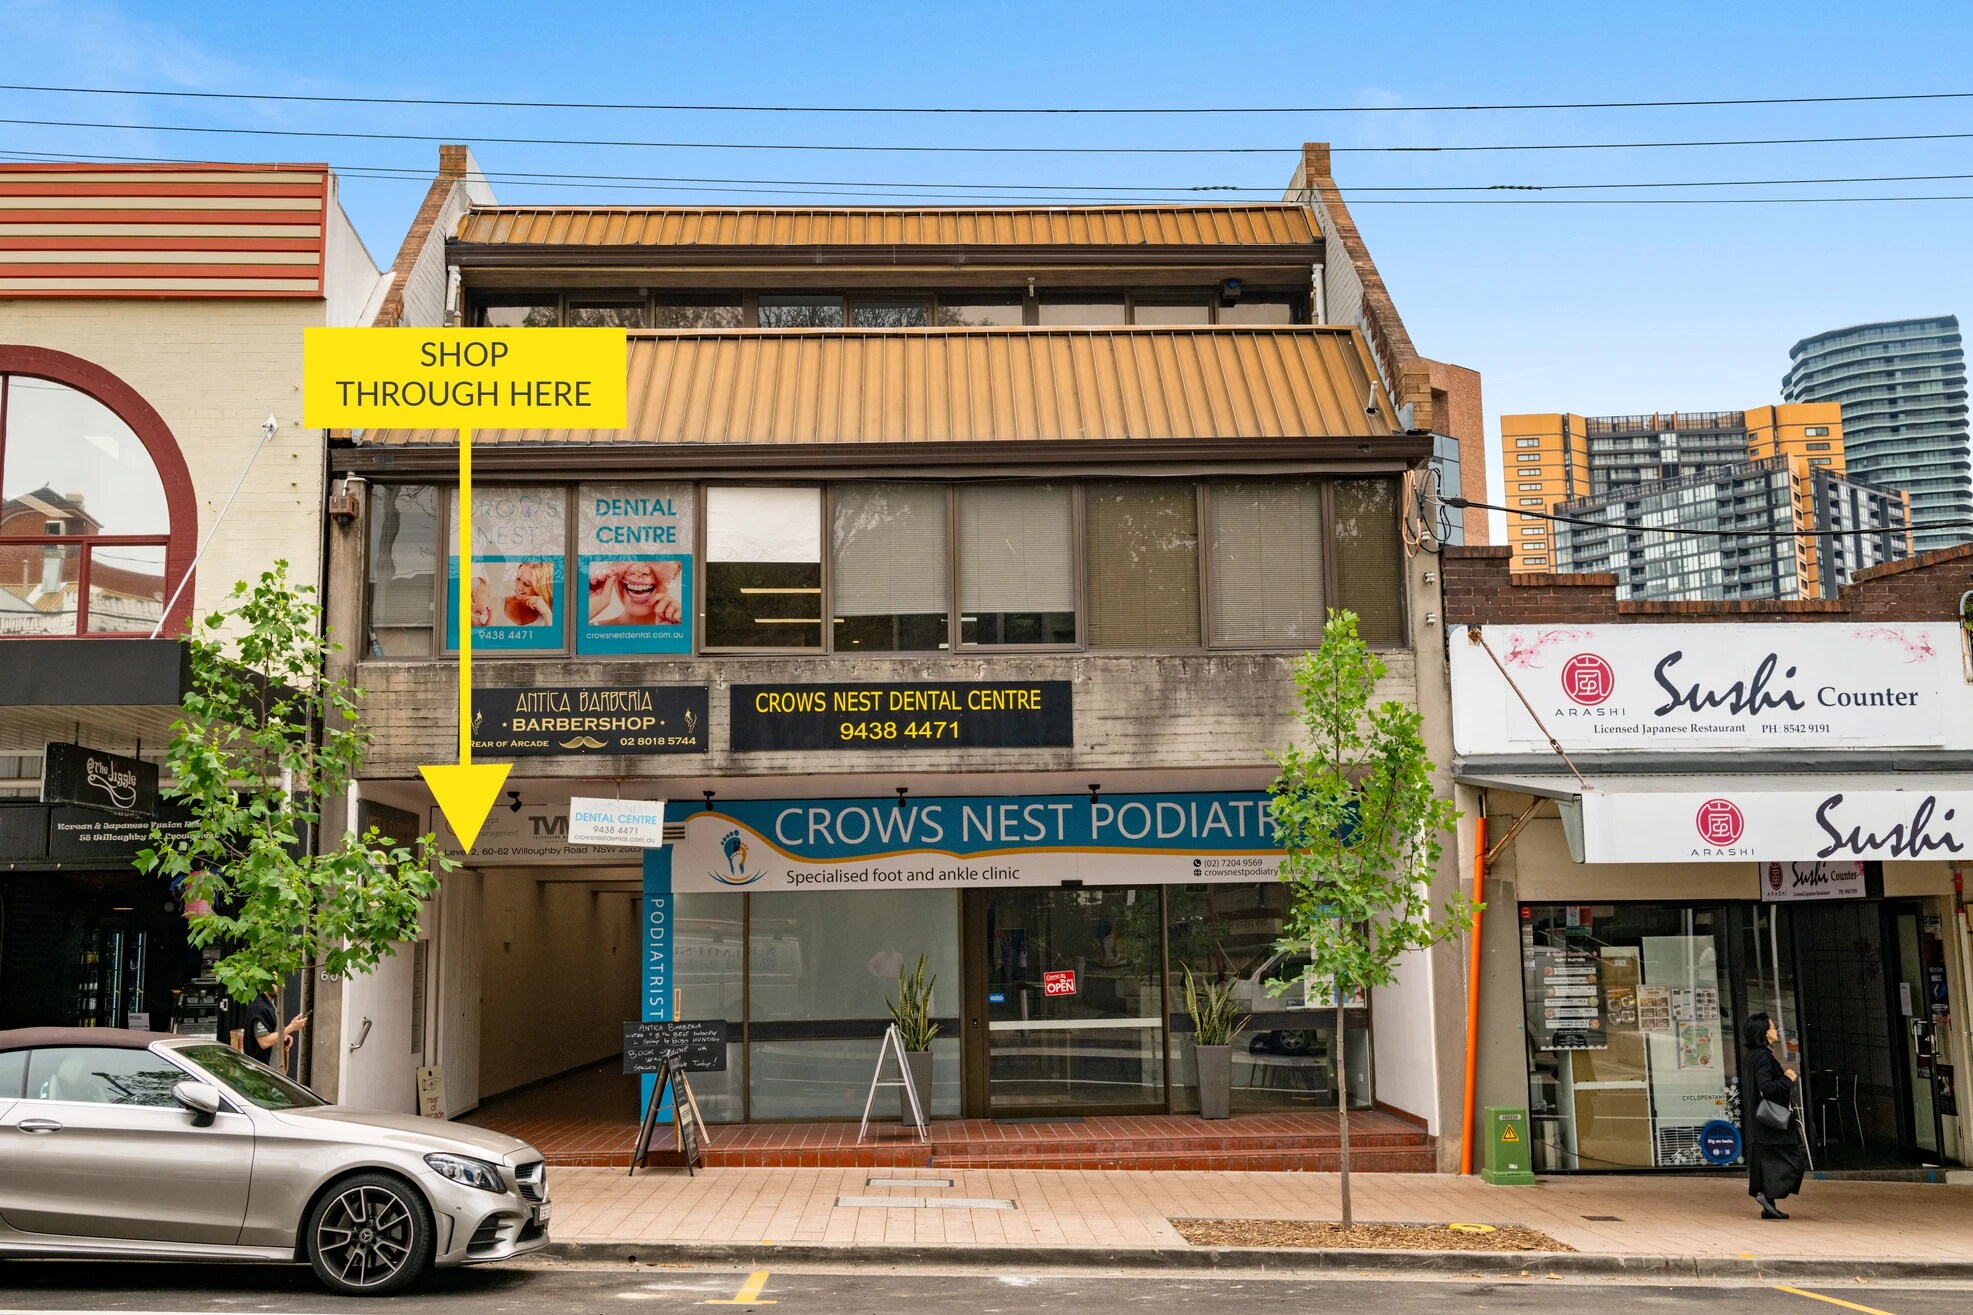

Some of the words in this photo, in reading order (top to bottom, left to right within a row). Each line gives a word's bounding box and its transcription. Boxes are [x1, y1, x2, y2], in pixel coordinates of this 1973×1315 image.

[595, 499, 677, 517] DENTAL
[477, 526, 537, 545] NEST
[596, 526, 677, 544] CENTRE
[478, 630, 505, 641] 9438
[508, 630, 534, 641] 4471
[586, 630, 684, 642] crowsnestdental.com.au
[1654, 651, 1805, 716] Sushi
[1817, 686, 1919, 707] Counter
[756, 692, 826, 713] CROWS
[834, 691, 883, 712] NEST
[890, 691, 962, 711] DENTAL
[968, 690, 1041, 710] CENTRE
[1555, 708, 1625, 717] ARASHI
[512, 717, 656, 732] BARBERSHOP
[1594, 724, 1639, 734] Licensed
[1642, 725, 1687, 735] Japanese
[1690, 724, 1746, 733] Restaurant
[1783, 724, 1806, 733] 8542
[1808, 724, 1830, 733] 9191
[840, 722, 897, 740] 9438
[904, 722, 960, 739] 4471
[620, 738, 635, 746] 02
[637, 737, 666, 745] 8018
[667, 737, 697, 745] 5744
[576, 813, 615, 823] DENTAL
[618, 815, 657, 824] CENTRE
[775, 806, 944, 845] CROWS
[962, 803, 1073, 842] NEST
[1091, 801, 1278, 840] PODIATR
[103, 822, 149, 830] Japanese
[594, 826, 615, 834] 9438
[1816, 794, 1964, 858] Sushi
[575, 834, 656, 843] crowsnestdental.com.au
[512, 847, 561, 856] Willoughby
[1204, 859, 1219, 867] (02)
[787, 869, 868, 886] Specialised
[873, 868, 902, 882] foot
[907, 867, 934, 881] and
[939, 867, 978, 881] ankle
[982, 867, 1020, 880] clinic
[1792, 861, 1829, 888] Sushi
[1831, 870, 1858, 881] Counter
[650, 899, 664, 1018] PODIATRIST
[321, 970, 338, 981] 60
[1047, 982, 1074, 993] OPEN
[628, 1049, 654, 1059] BOOK
